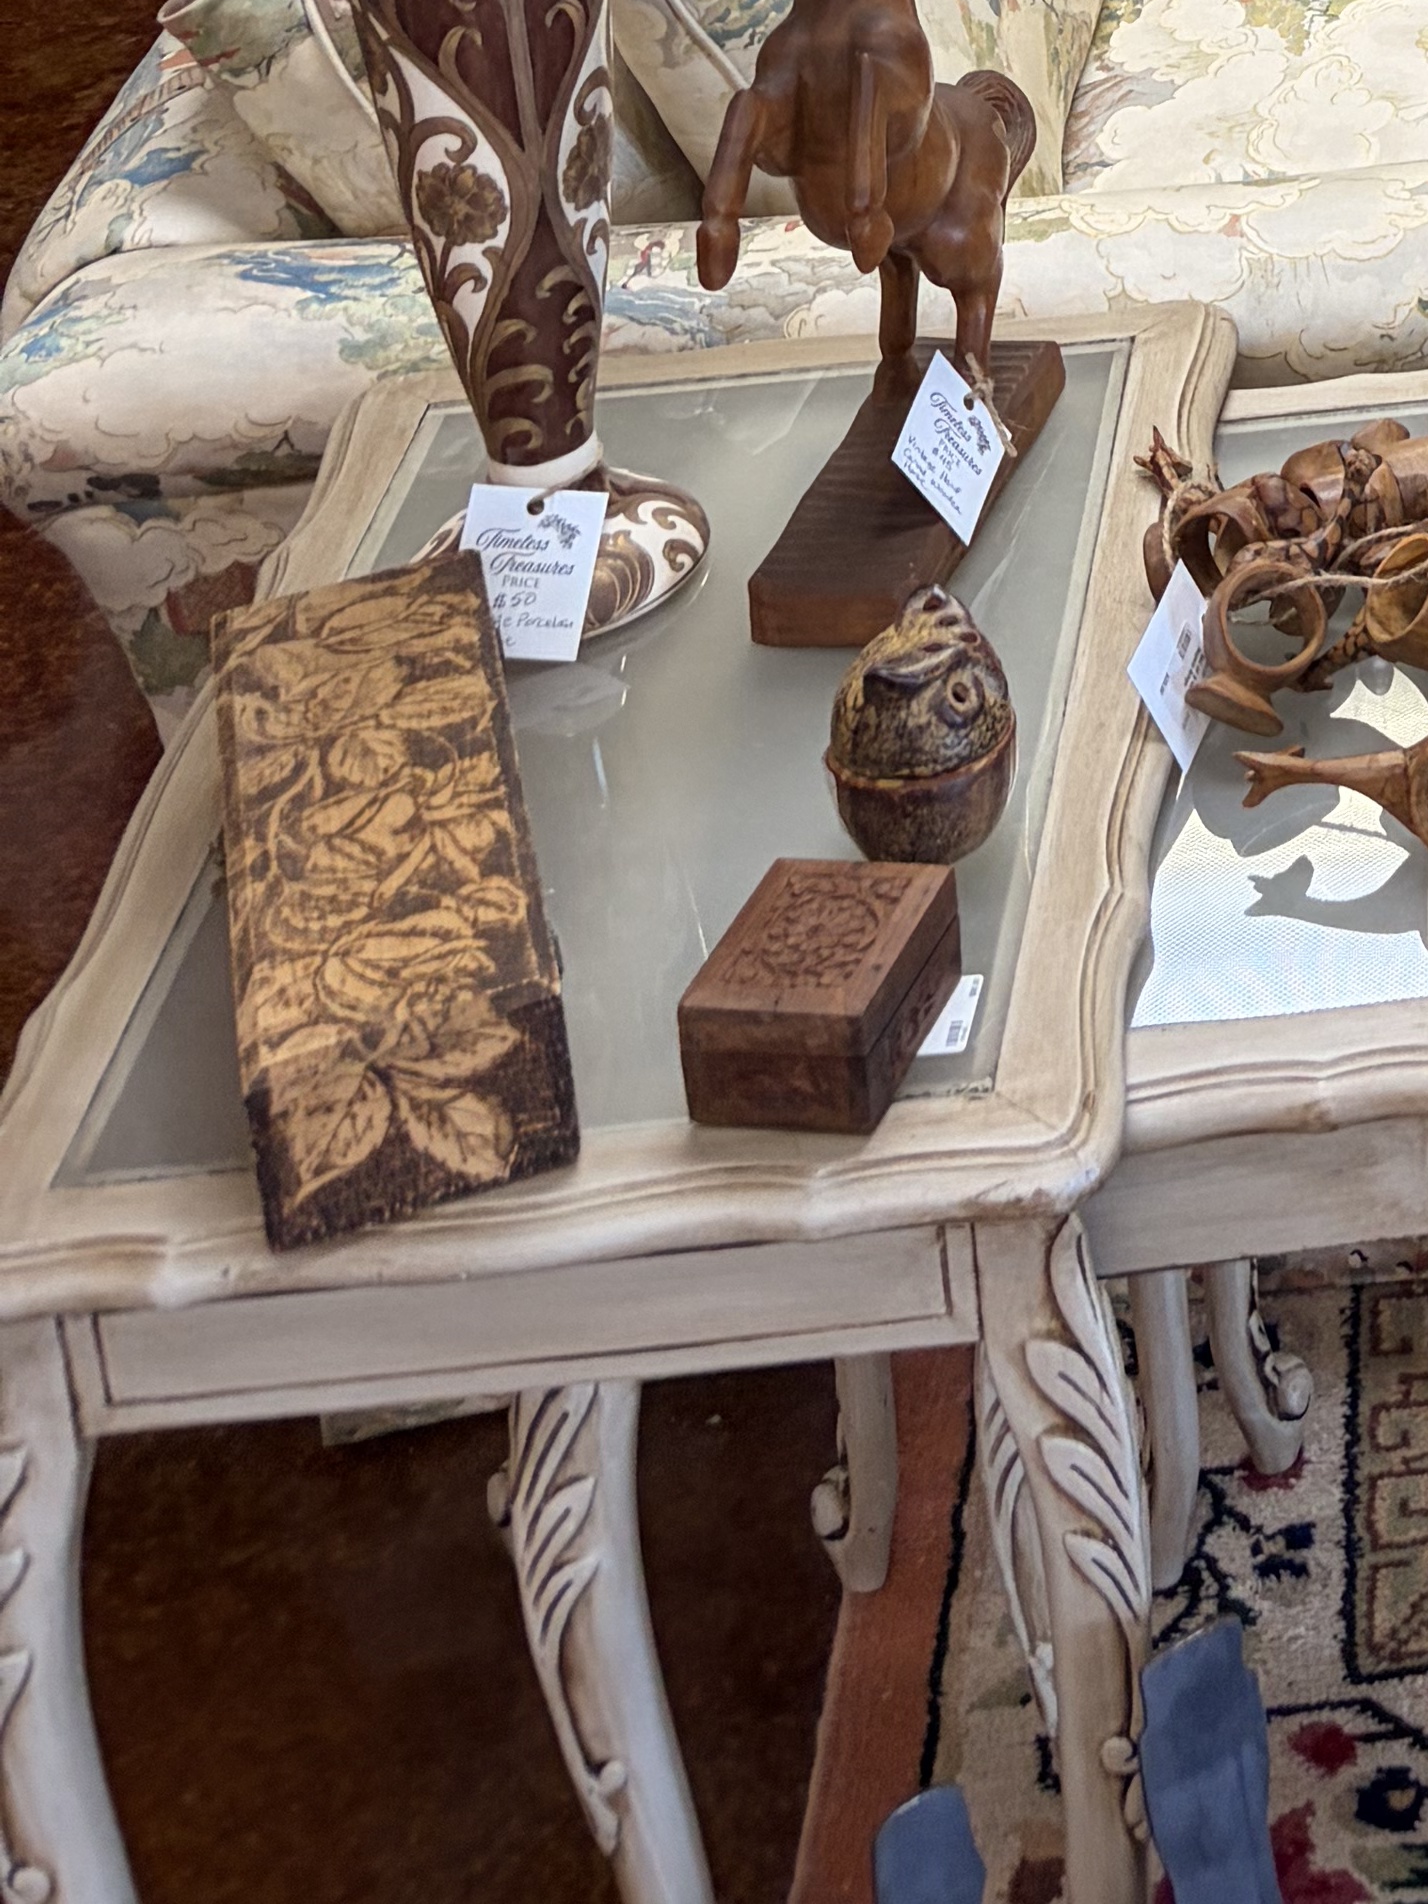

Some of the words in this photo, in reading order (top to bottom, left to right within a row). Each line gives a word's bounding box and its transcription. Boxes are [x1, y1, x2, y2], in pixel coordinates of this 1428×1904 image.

[929, 392, 971, 442] Timeless
[934, 417, 983, 475] Treasures
[475, 527, 550, 551] Timeless
[489, 551, 576, 577] Treasures
[501, 576, 541, 589] PRICE
